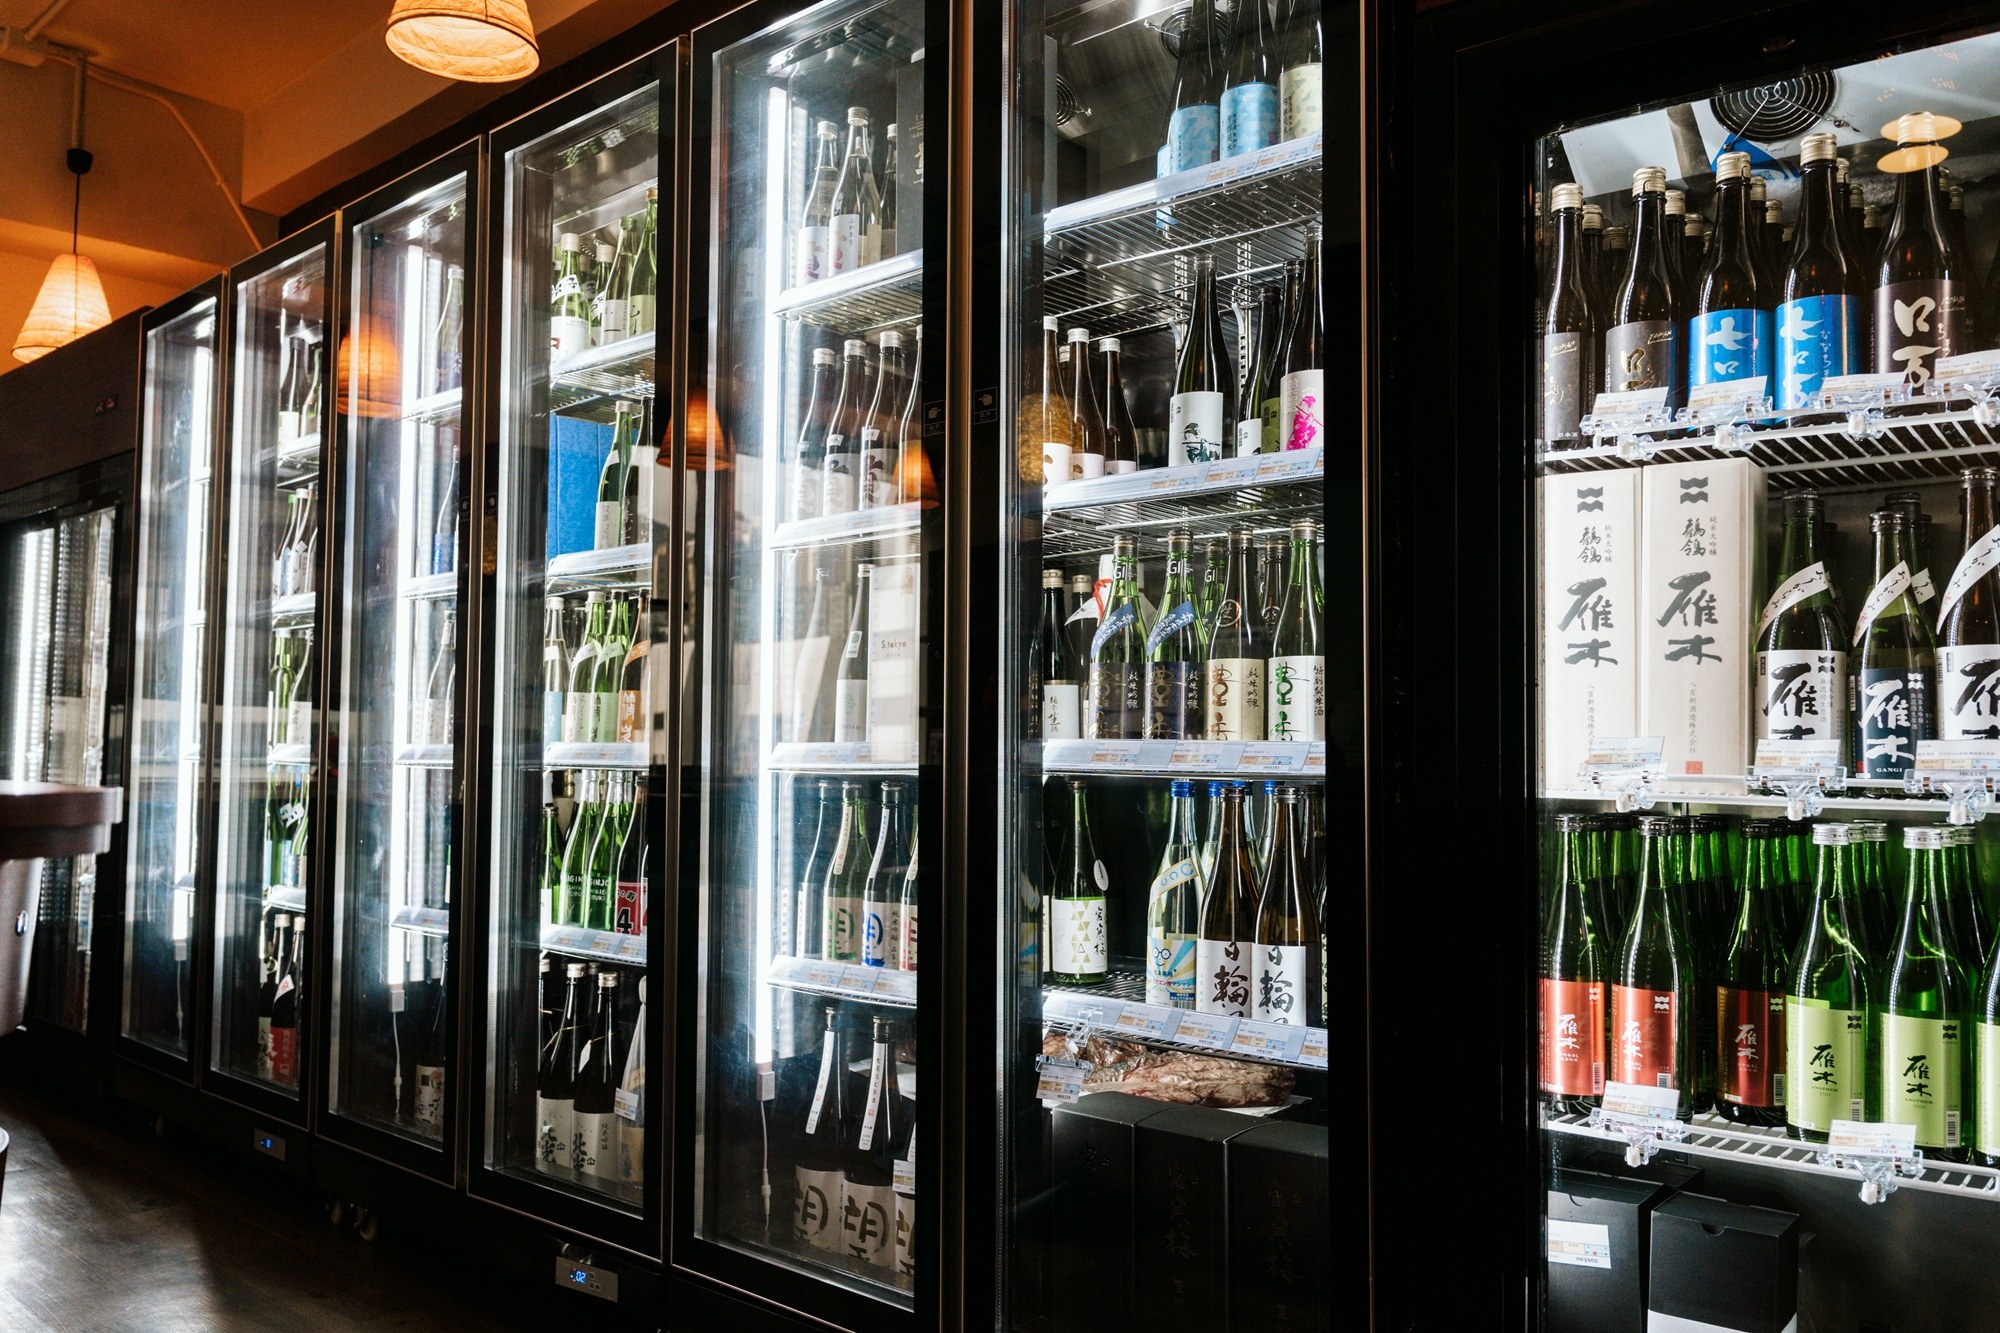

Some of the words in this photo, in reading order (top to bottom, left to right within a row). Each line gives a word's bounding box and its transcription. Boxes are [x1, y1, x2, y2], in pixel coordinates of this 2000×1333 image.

[1558, 577, 1618, 668] 雁木
[1656, 571, 1722, 666] 雁木
[1858, 679, 1915, 763] 雁木
[1212, 941, 1249, 1017] 日輪
[1259, 945, 1294, 1024] 日輪
[1809, 1044, 1838, 1085] 雁木
[1903, 1055, 1932, 1096] 雁木
